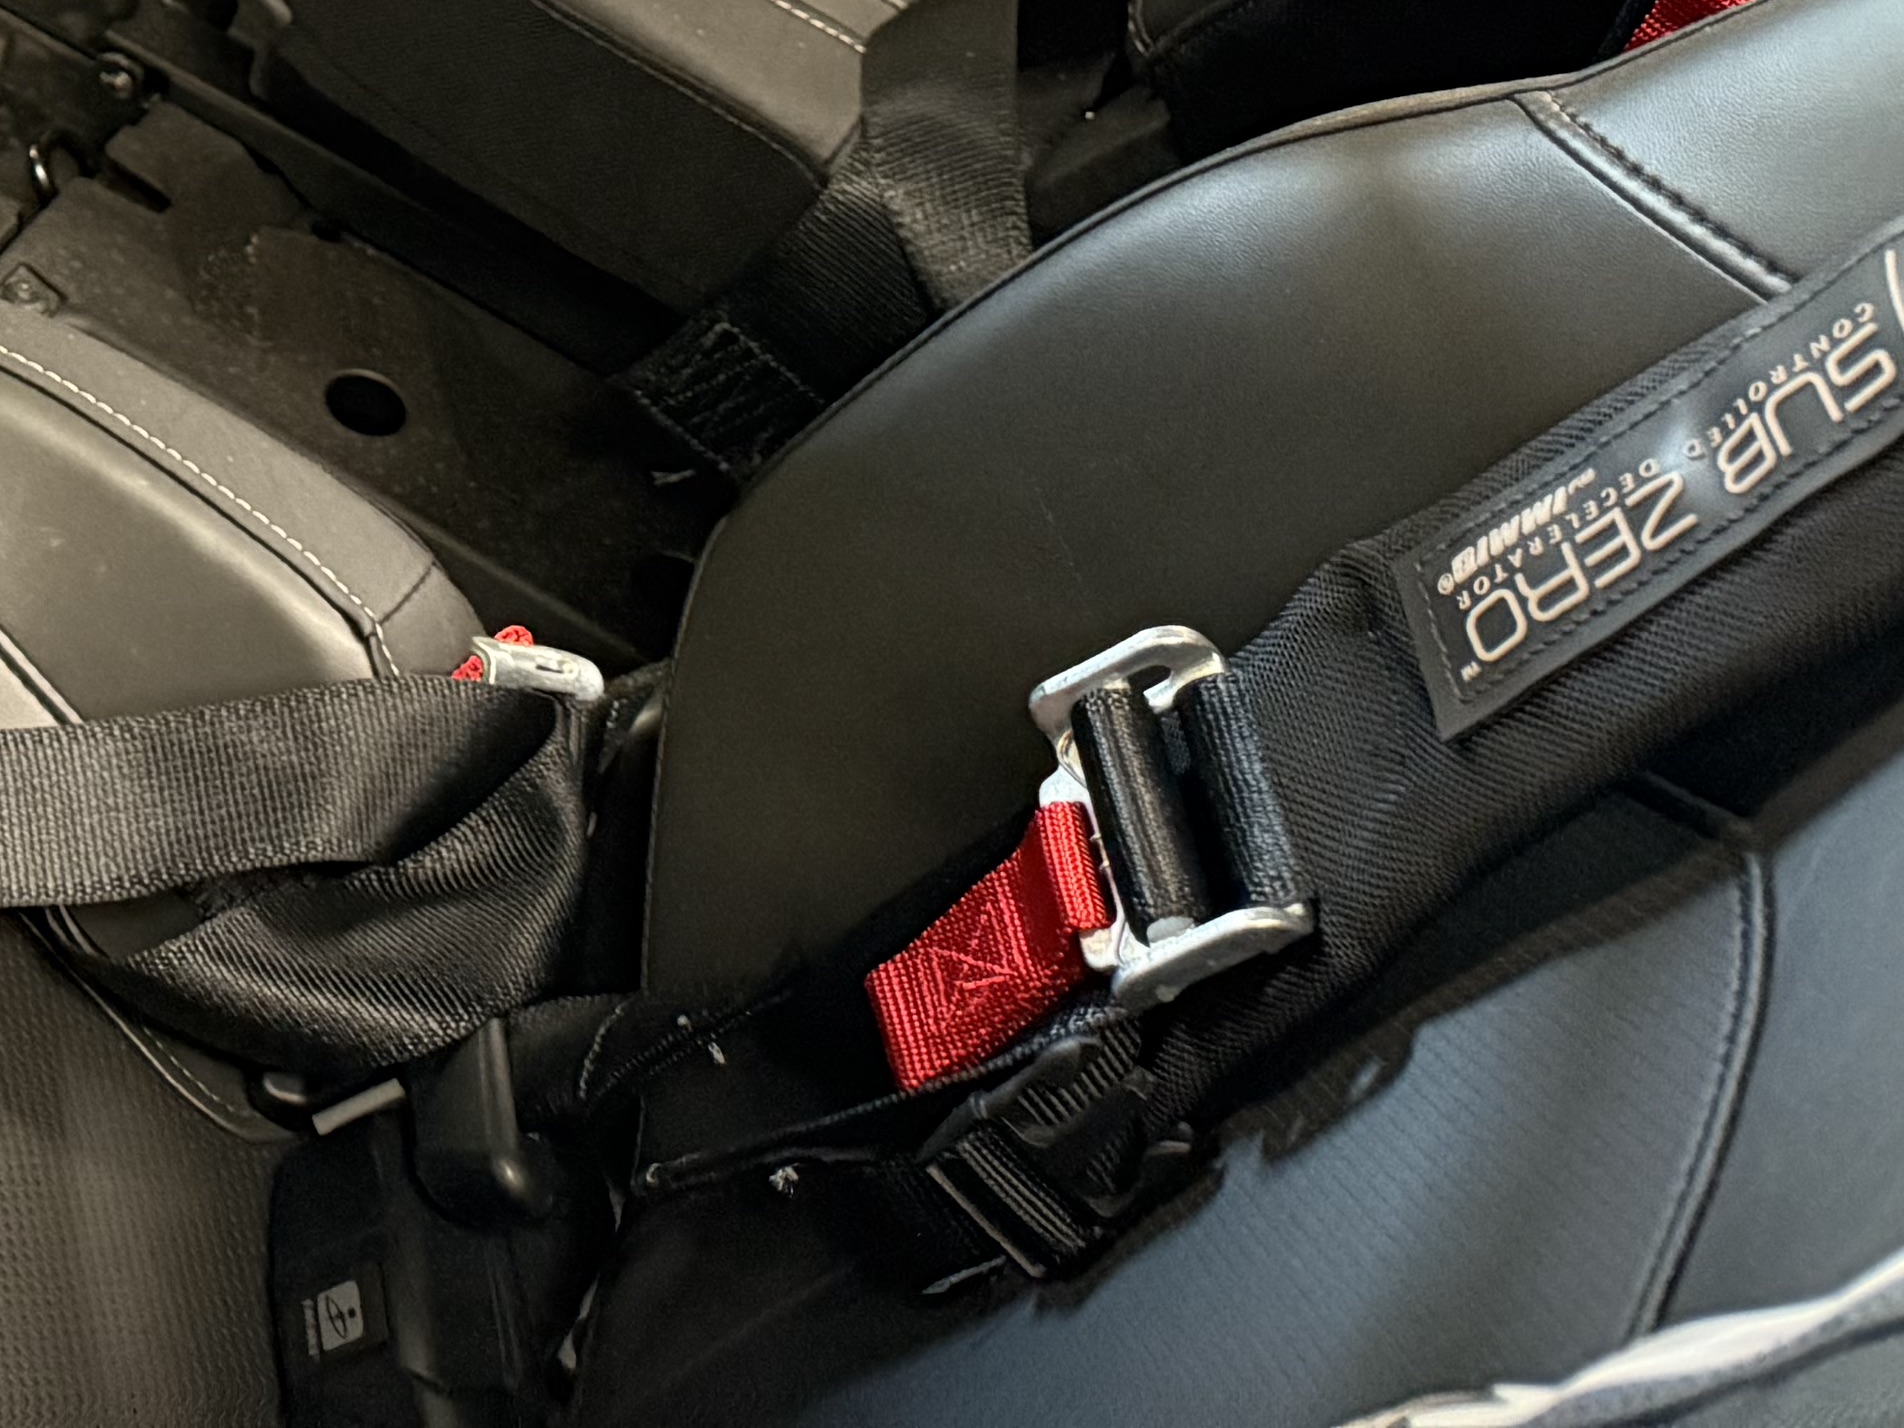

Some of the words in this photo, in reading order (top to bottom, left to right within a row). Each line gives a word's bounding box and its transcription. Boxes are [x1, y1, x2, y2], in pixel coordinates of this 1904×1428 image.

[1682, 301, 1875, 461] CONTROLLED
[1717, 321, 1896, 494] SUB
[1455, 458, 1660, 611] DECELERATOR
